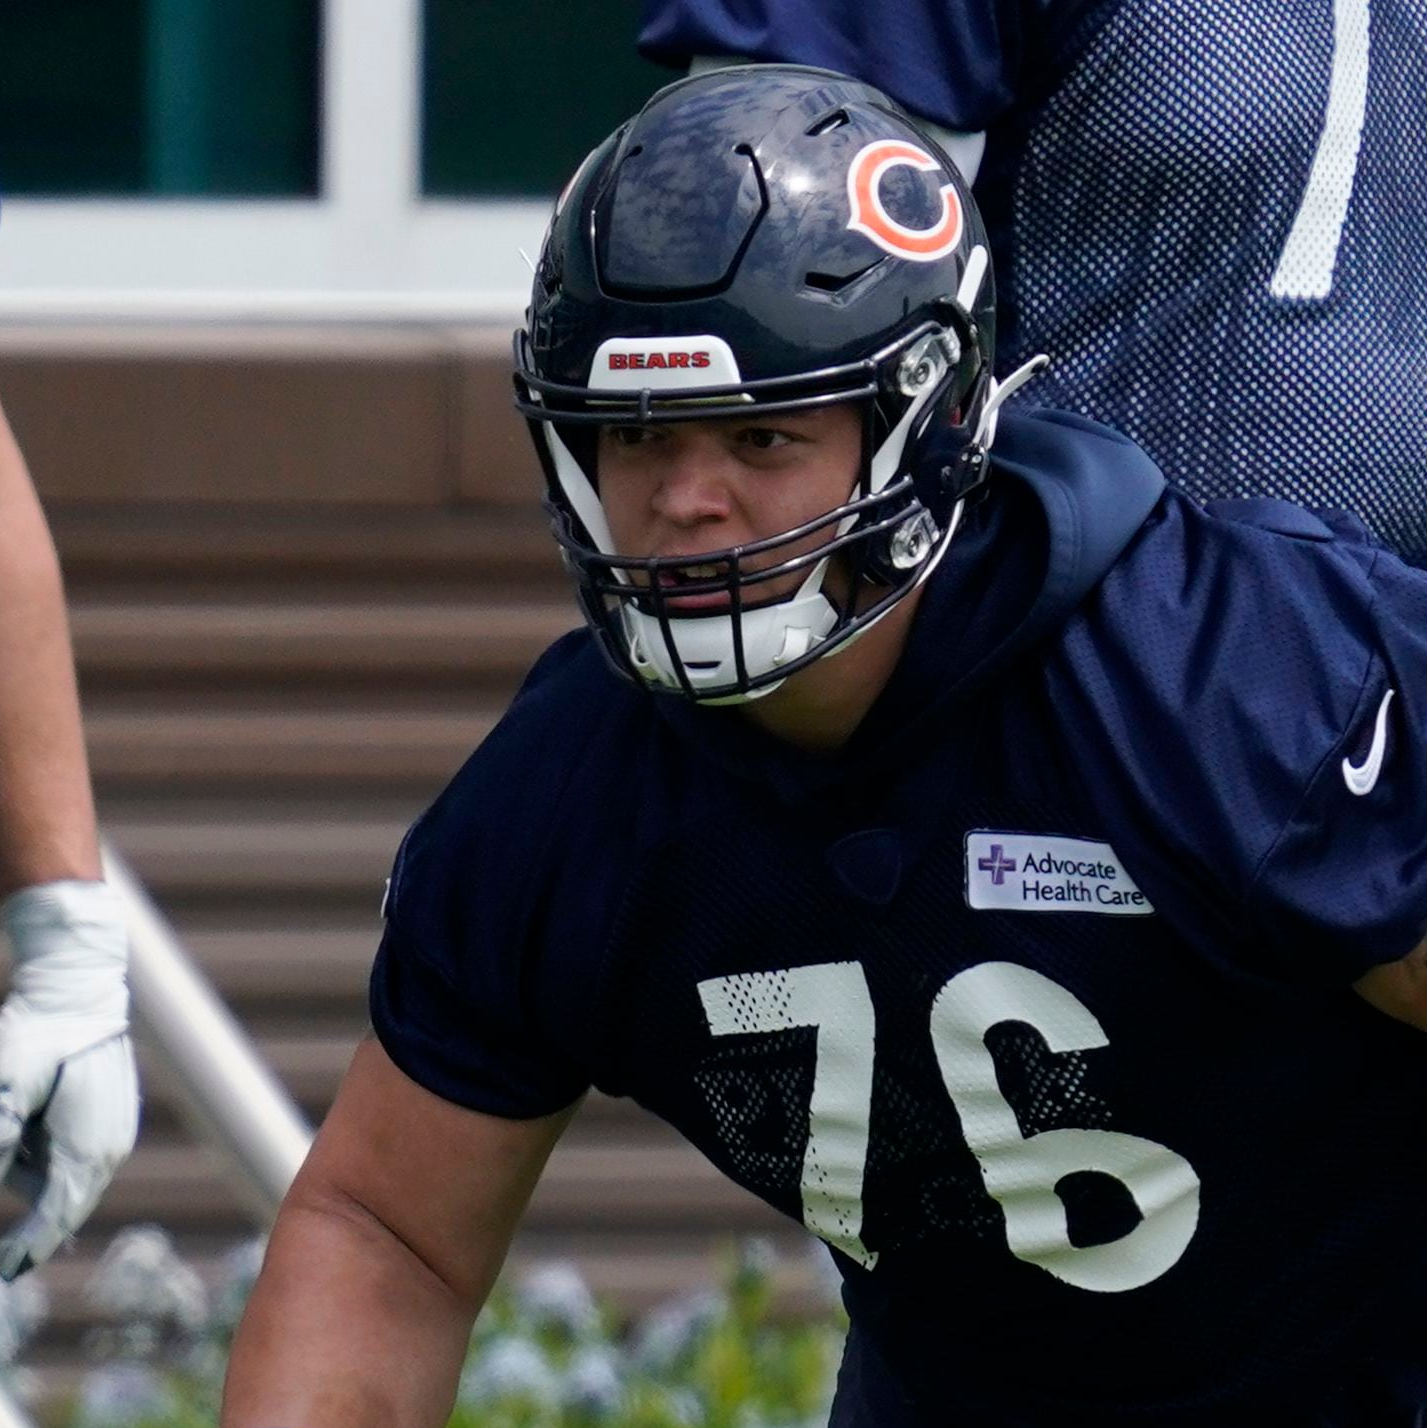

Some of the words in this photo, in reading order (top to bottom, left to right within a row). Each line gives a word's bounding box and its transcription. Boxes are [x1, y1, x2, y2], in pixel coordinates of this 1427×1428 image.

[608, 351, 711, 371] BEARS
[1021, 852, 1117, 880] Advocate
[1022, 880, 1092, 903] Health
[1094, 884, 1145, 906] Care
[696, 960, 1202, 1294] 76
